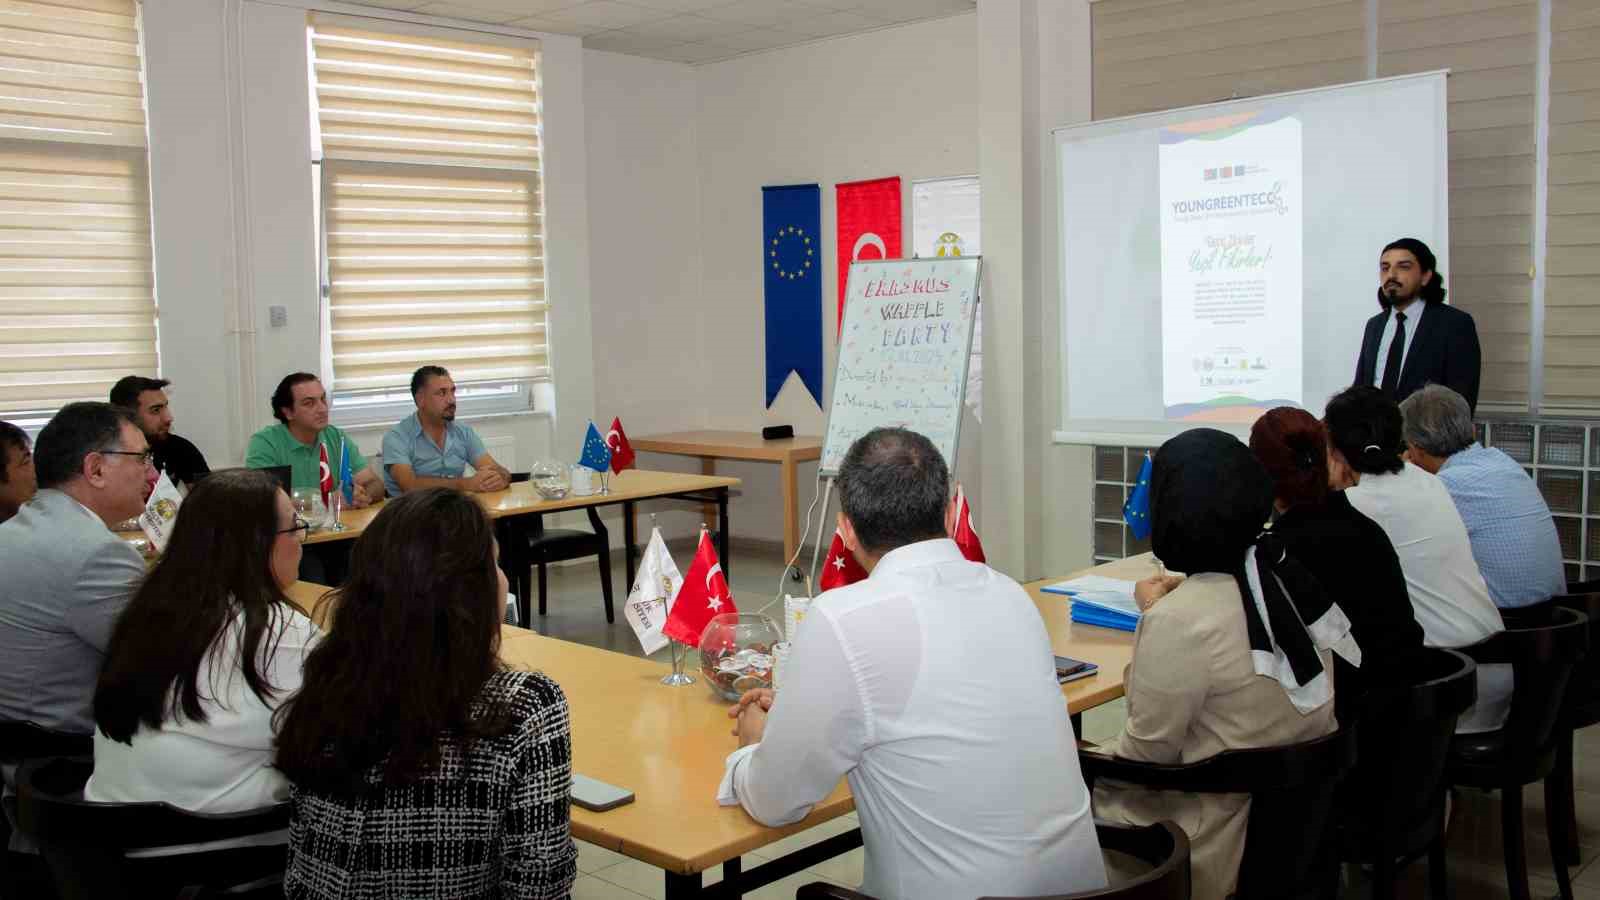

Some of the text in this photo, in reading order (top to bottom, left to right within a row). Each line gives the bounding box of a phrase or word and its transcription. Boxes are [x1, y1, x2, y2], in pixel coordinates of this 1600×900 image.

[864, 278, 953, 298] ERASMUS
[880, 300, 945, 321] WAFFLE
[882, 322, 952, 347] PARTY
